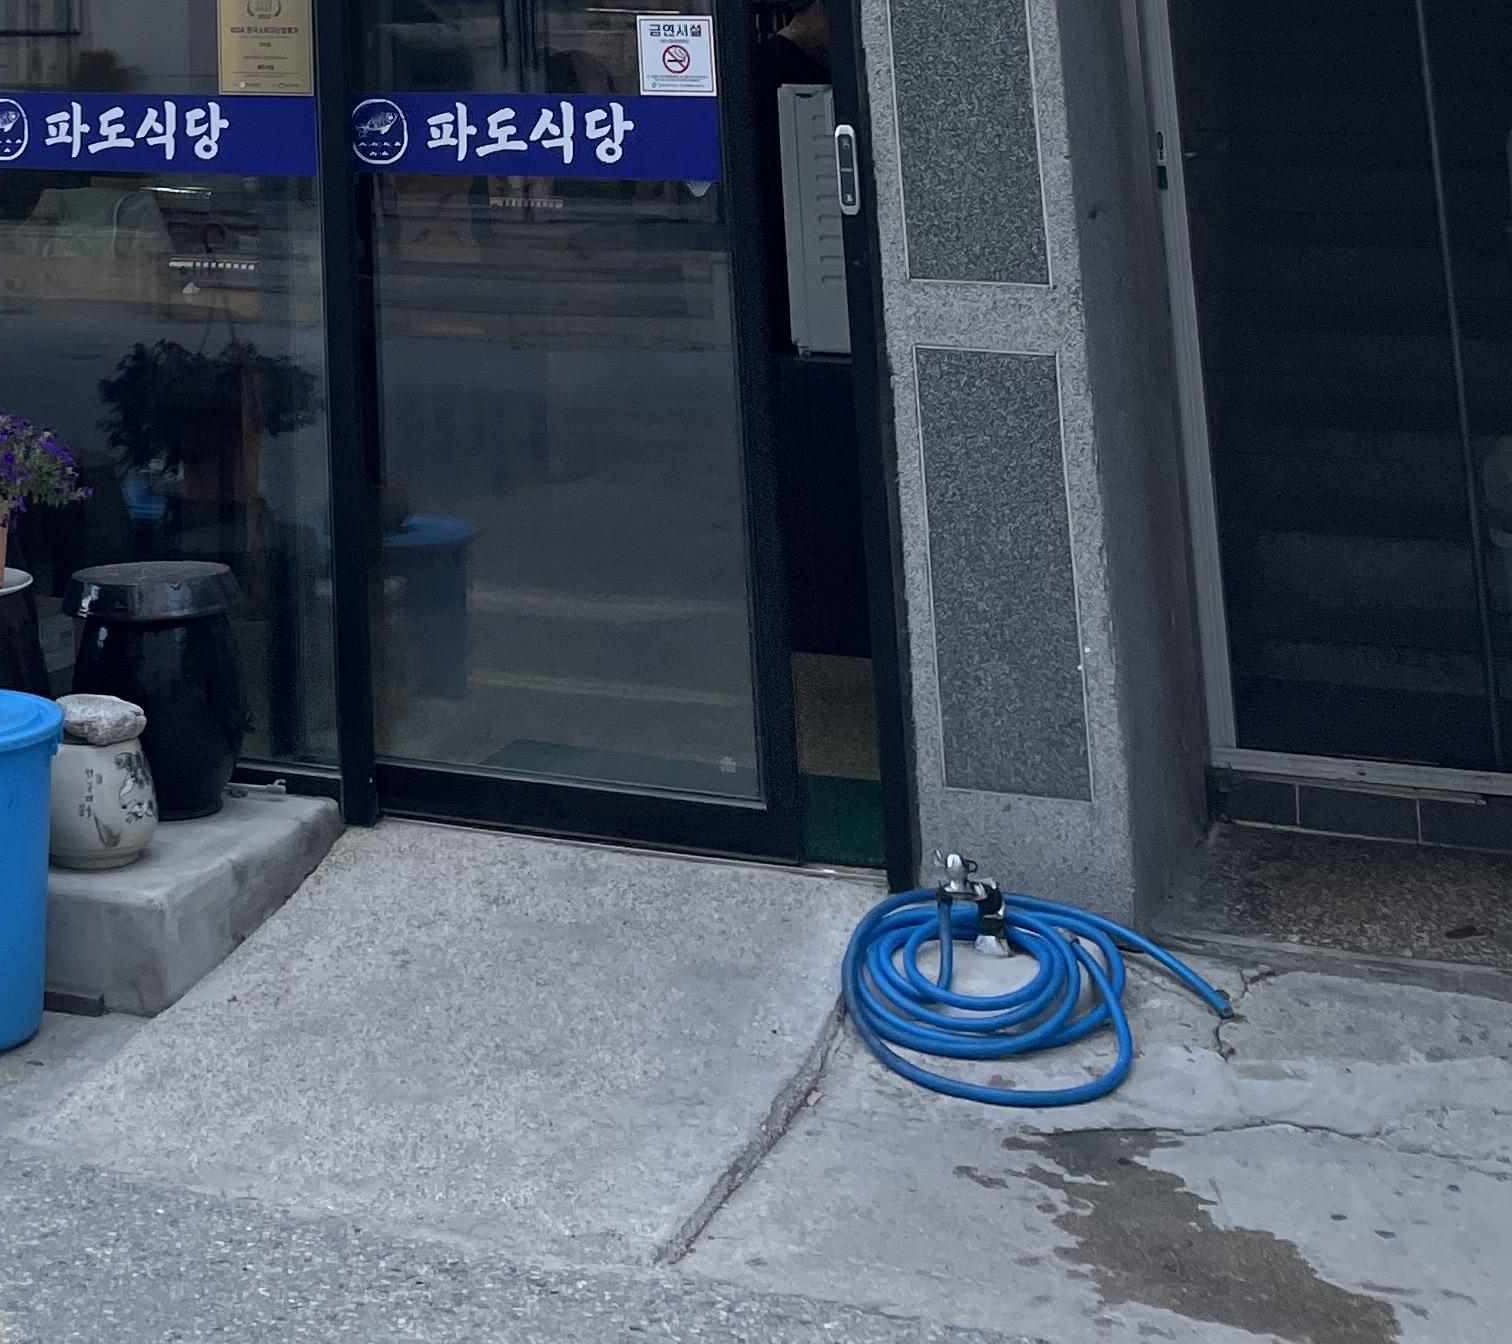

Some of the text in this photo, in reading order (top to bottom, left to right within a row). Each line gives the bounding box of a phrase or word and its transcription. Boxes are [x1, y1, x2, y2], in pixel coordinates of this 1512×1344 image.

[649, 23, 702, 37] 금연시설
[45, 100, 230, 160] 파도식당
[426, 100, 634, 164] 파도식당
